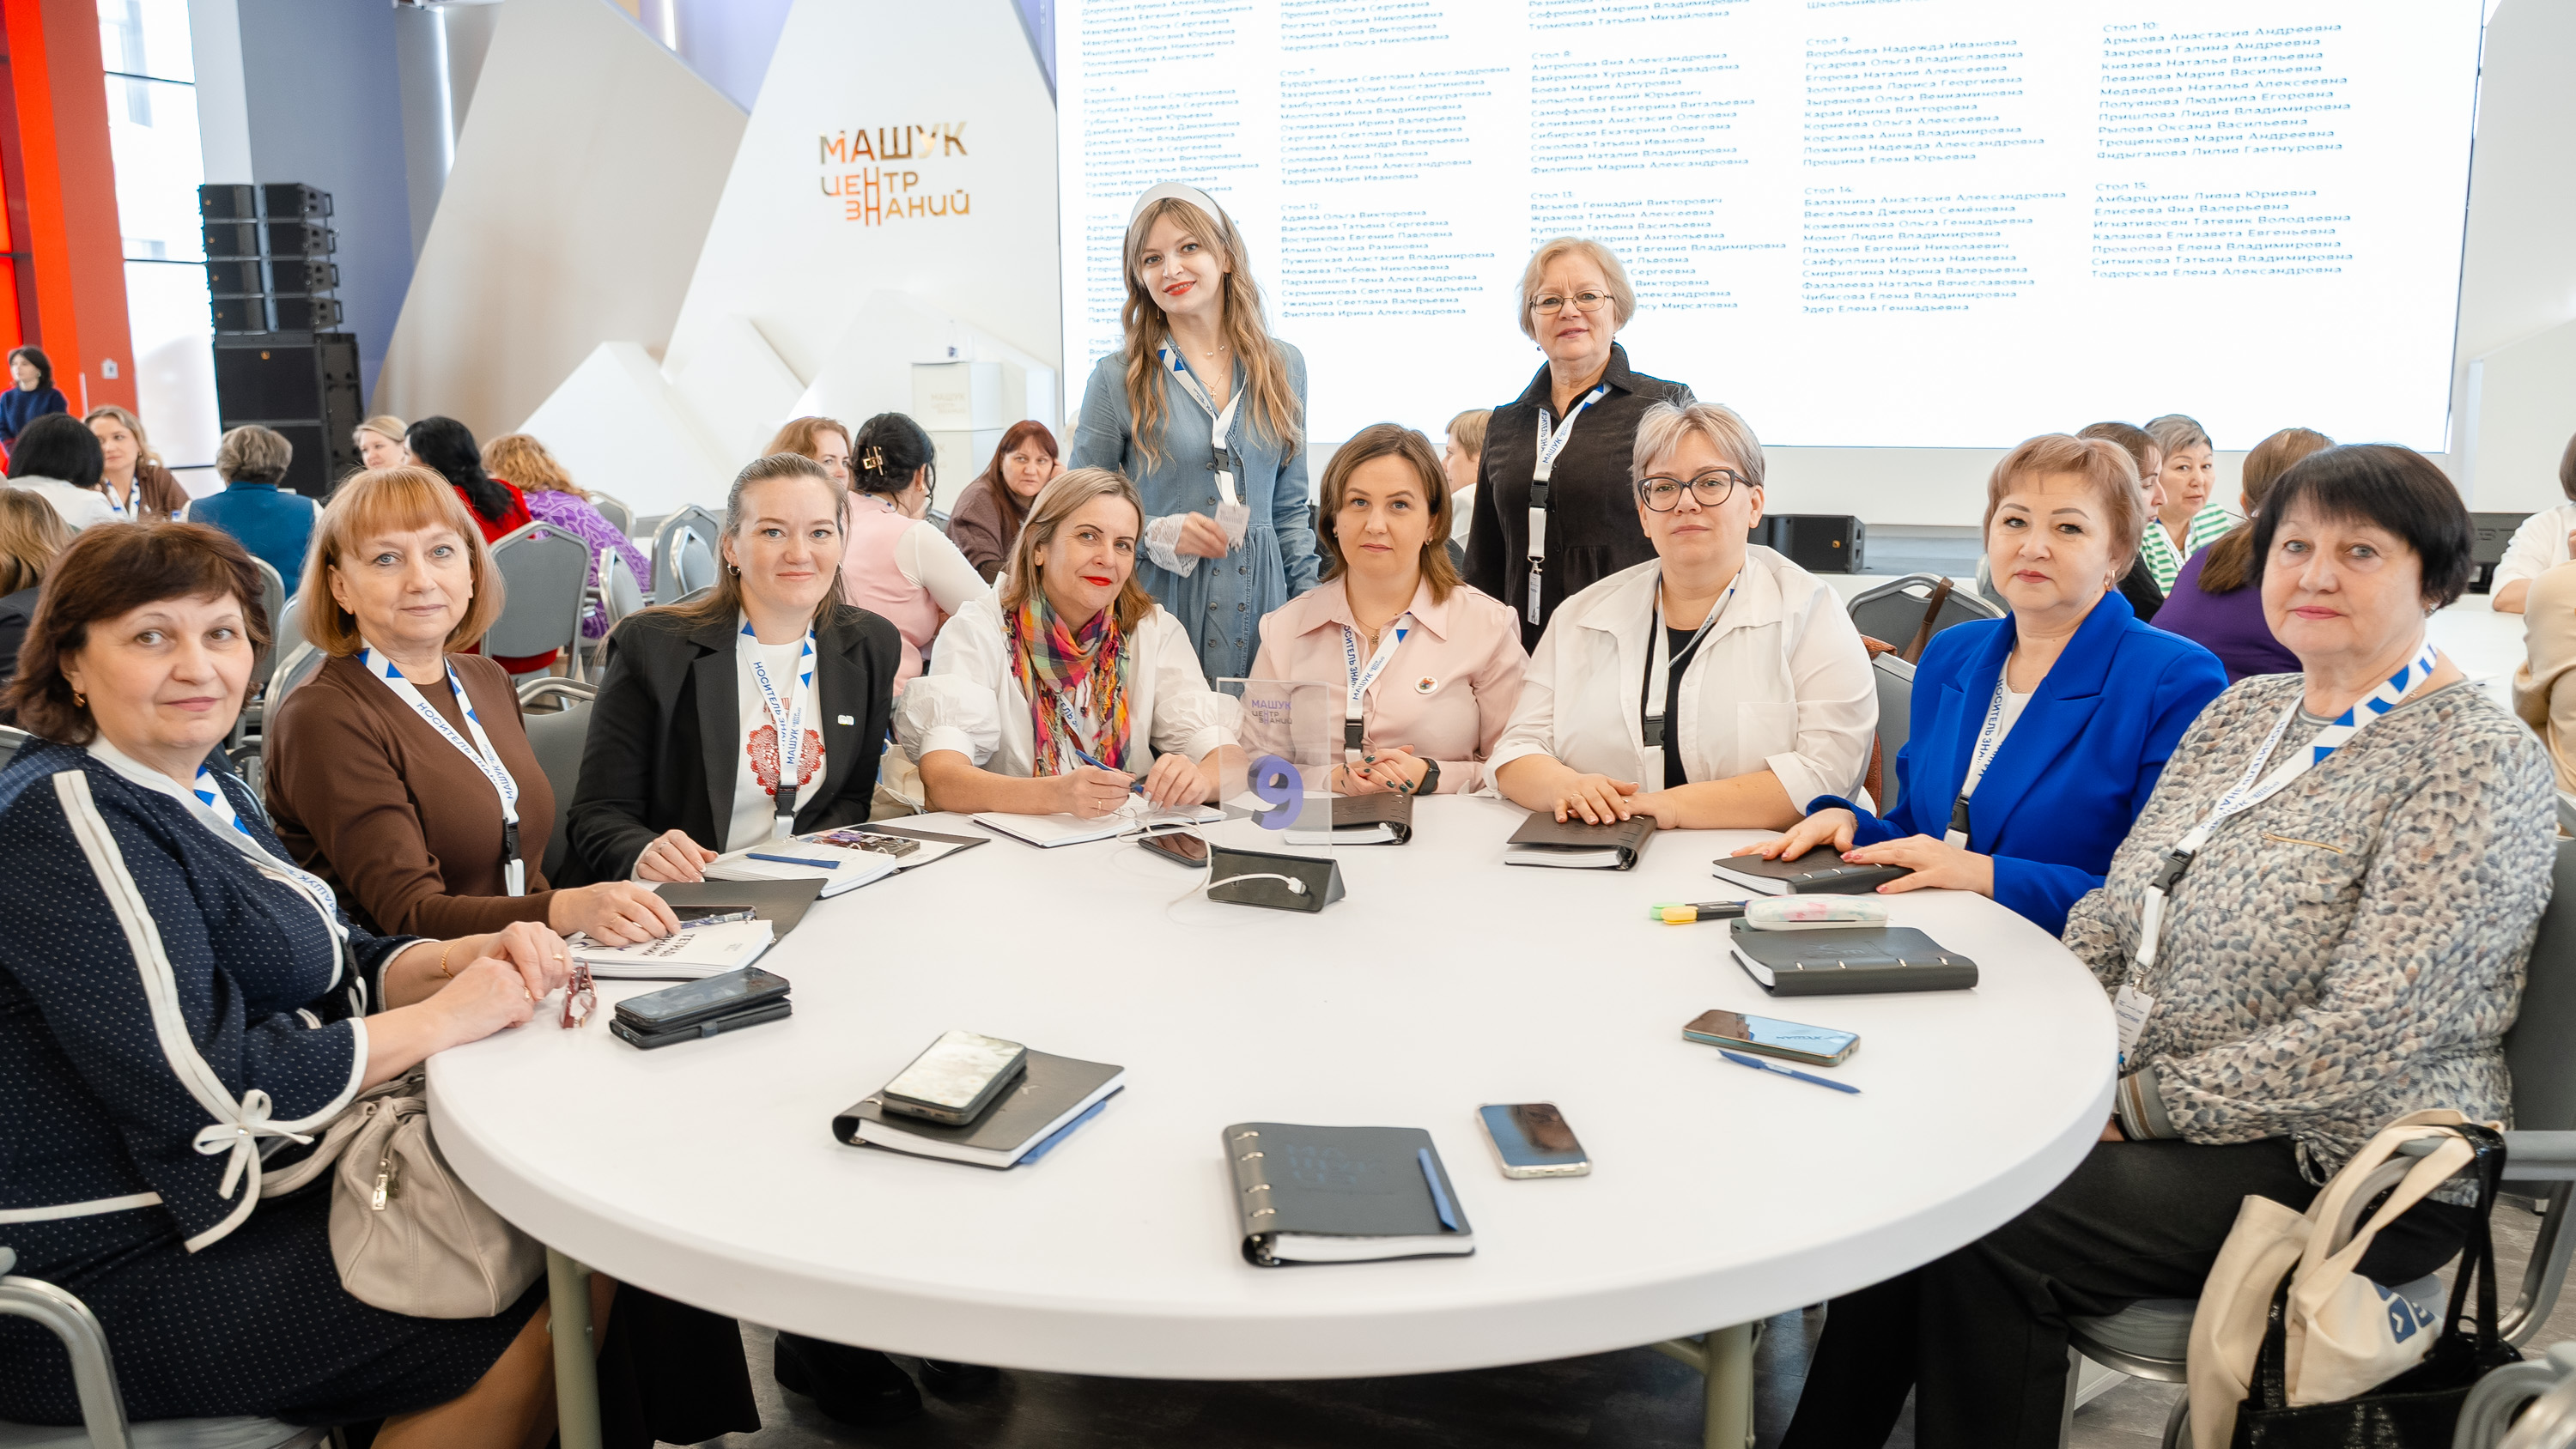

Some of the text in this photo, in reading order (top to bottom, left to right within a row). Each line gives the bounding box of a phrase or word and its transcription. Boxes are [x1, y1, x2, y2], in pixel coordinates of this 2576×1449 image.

[819, 121, 968, 165] МАШУК
[821, 167, 919, 197] ЦЕНТР
[846, 190, 969, 226] ЗНАНИЙ
[1542, 438, 1562, 464] МАШУК
[1344, 625, 1356, 665] ОСИТЕЛЬ
[753, 661, 781, 716] НОСИТЕЛЬ
[1352, 672, 1374, 700] МАШУК
[1251, 700, 1291, 711] МАШУК
[1252, 709, 1279, 718] ЦЕНТР
[1259, 716, 1292, 724] ЗНАНИЙ
[1984, 678, 2004, 737] НОСИТЕЛЬ
[416, 702, 472, 755] НОСИТЕЛЬ
[787, 729, 799, 764] МАШУК
[492, 765, 513, 799] МАШУК
[1247, 755, 1303, 830] 9
